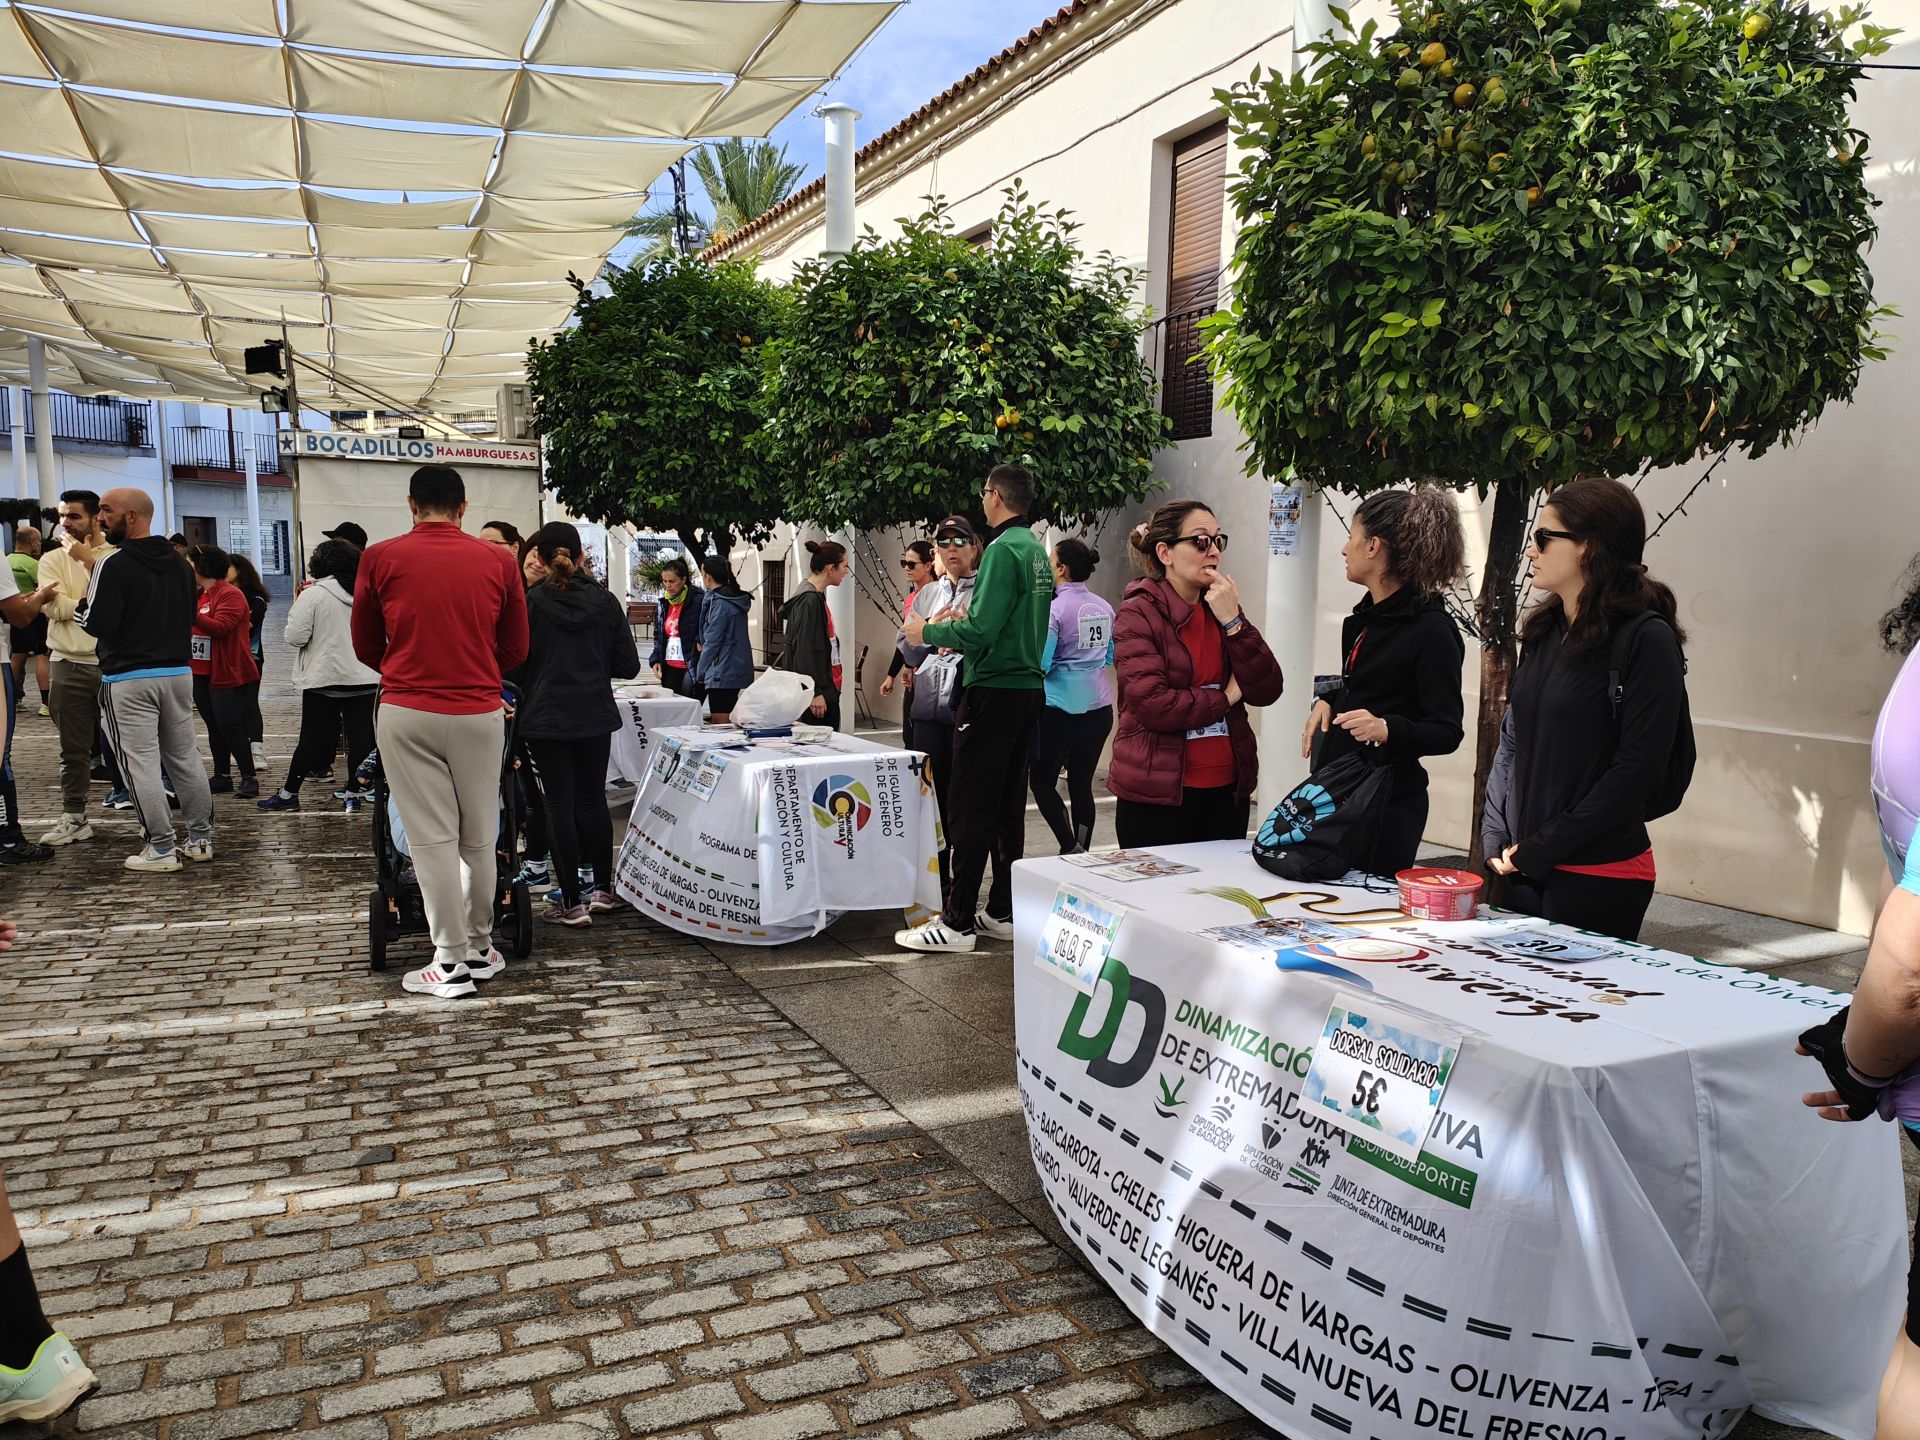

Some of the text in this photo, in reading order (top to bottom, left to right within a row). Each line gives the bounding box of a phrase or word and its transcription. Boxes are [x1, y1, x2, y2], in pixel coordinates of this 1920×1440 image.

[306, 435, 536, 461] BOCADILLOS HAMBURGUESAS
[1089, 625, 1102, 641] 29
[192, 642, 205, 654] 54
[887, 758, 898, 771] DE
[876, 775, 887, 788] DE
[878, 791, 892, 837] GÉNERO
[888, 774, 904, 829] IGUALDAD
[699, 832, 758, 860] PROGRAMA DE
[795, 850, 805, 865] DE
[659, 865, 668, 880] DE
[669, 871, 698, 894] VARGAS
[781, 841, 795, 891] CULTURA
[651, 879, 696, 911] VILLANUEVA
[698, 902, 718, 918] DEL
[1514, 939, 1569, 954] 30
[1675, 967, 1723, 981] de
[1160, 1033, 1191, 1066] DE
[1174, 999, 1313, 1079] DINAMIZACIÓ
[1330, 1029, 1439, 1088] DORSAL SOLIDARIO
[1351, 1069, 1388, 1114] 5€
[1188, 1124, 1231, 1153] DE BADAJOZ
[1193, 1114, 1235, 1143] DIPUTACIÓN
[1239, 1154, 1248, 1165] DE
[1243, 1143, 1284, 1171] DIPUTACIÓN
[1326, 1191, 1446, 1254] DIRECCIÓN GENERAL DE DEPORTES
[1331, 1174, 1357, 1199] JUNTA
[1355, 1187, 1370, 1206] DE
[1368, 1194, 1446, 1243] EXTREMADURA
[1040, 1111, 1102, 1180] BARCARROTA
[1111, 1170, 1165, 1223] CHELES
[1174, 1214, 1255, 1290] HIGUERA
[1259, 1270, 1294, 1312] DE
[1300, 1291, 1415, 1375] VARGAS
[1450, 1363, 1610, 1414] OLIVENZA
[1067, 1173, 1122, 1237] VALVERDE
[1119, 1219, 1142, 1253] DE
[1140, 1235, 1218, 1311] LEGANÉS
[1239, 1301, 1403, 1420] VILLANUEVA
[1414, 1397, 1475, 1439] DEL
